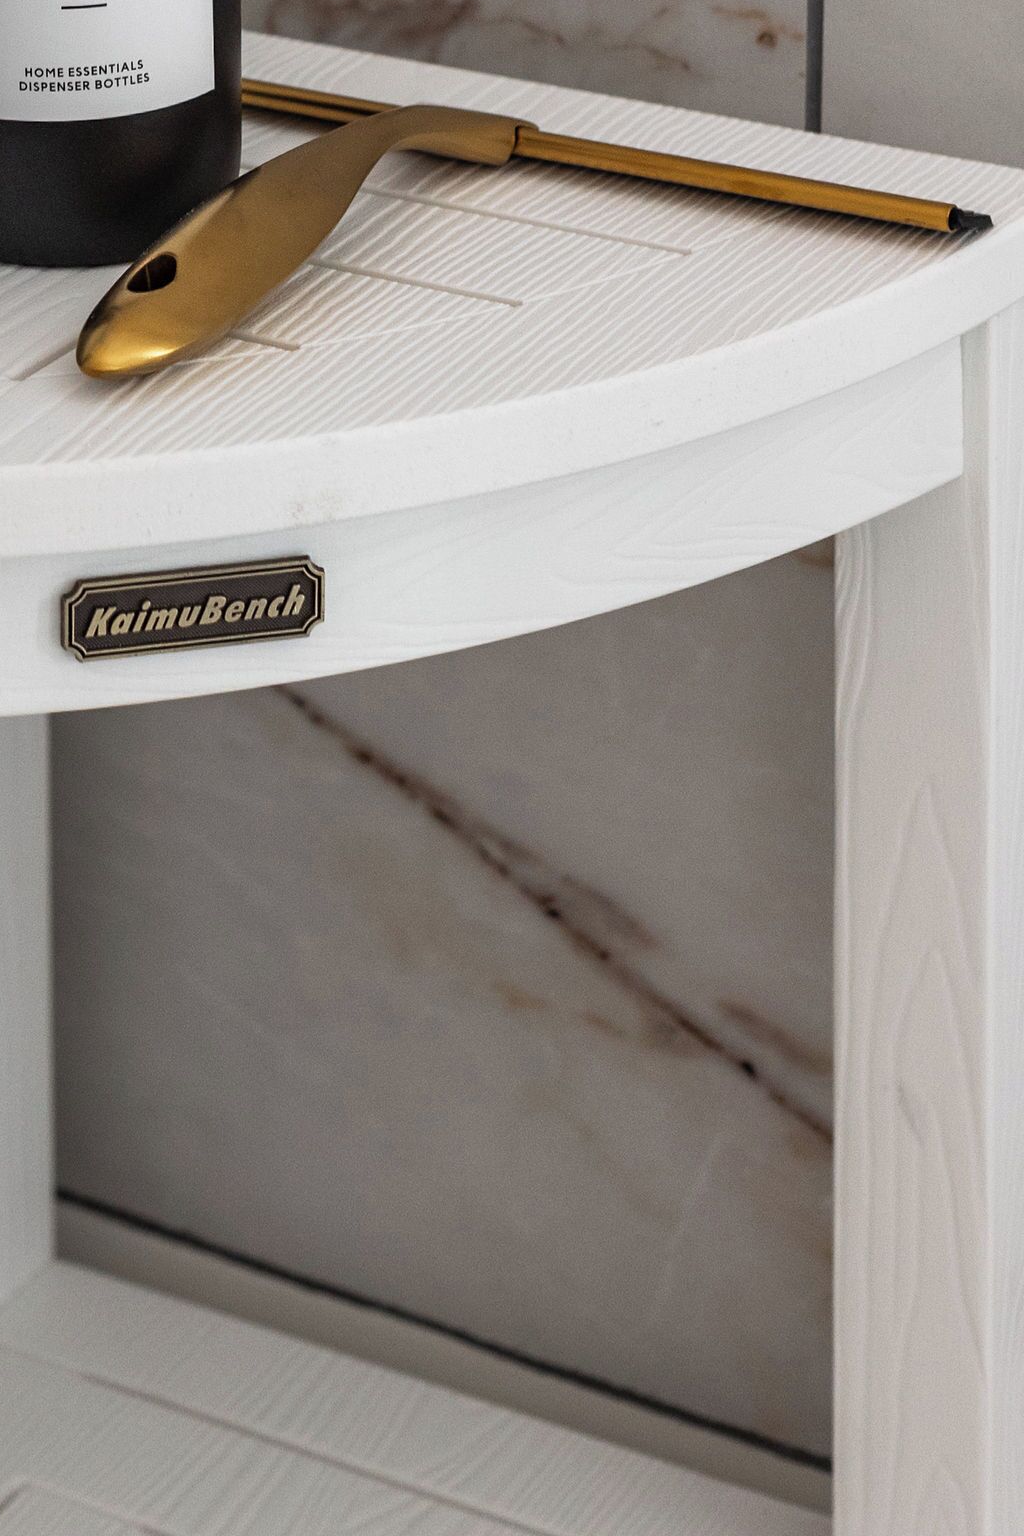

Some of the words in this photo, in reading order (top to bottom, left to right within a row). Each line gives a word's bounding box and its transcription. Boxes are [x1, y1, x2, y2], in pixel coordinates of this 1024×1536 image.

[24, 66, 65, 79] HOME
[67, 59, 144, 78] ESSENTIALS
[18, 79, 90, 93] DISPENSER
[94, 72, 150, 91] BOTTLES
[84, 583, 307, 639] KaimuBench
